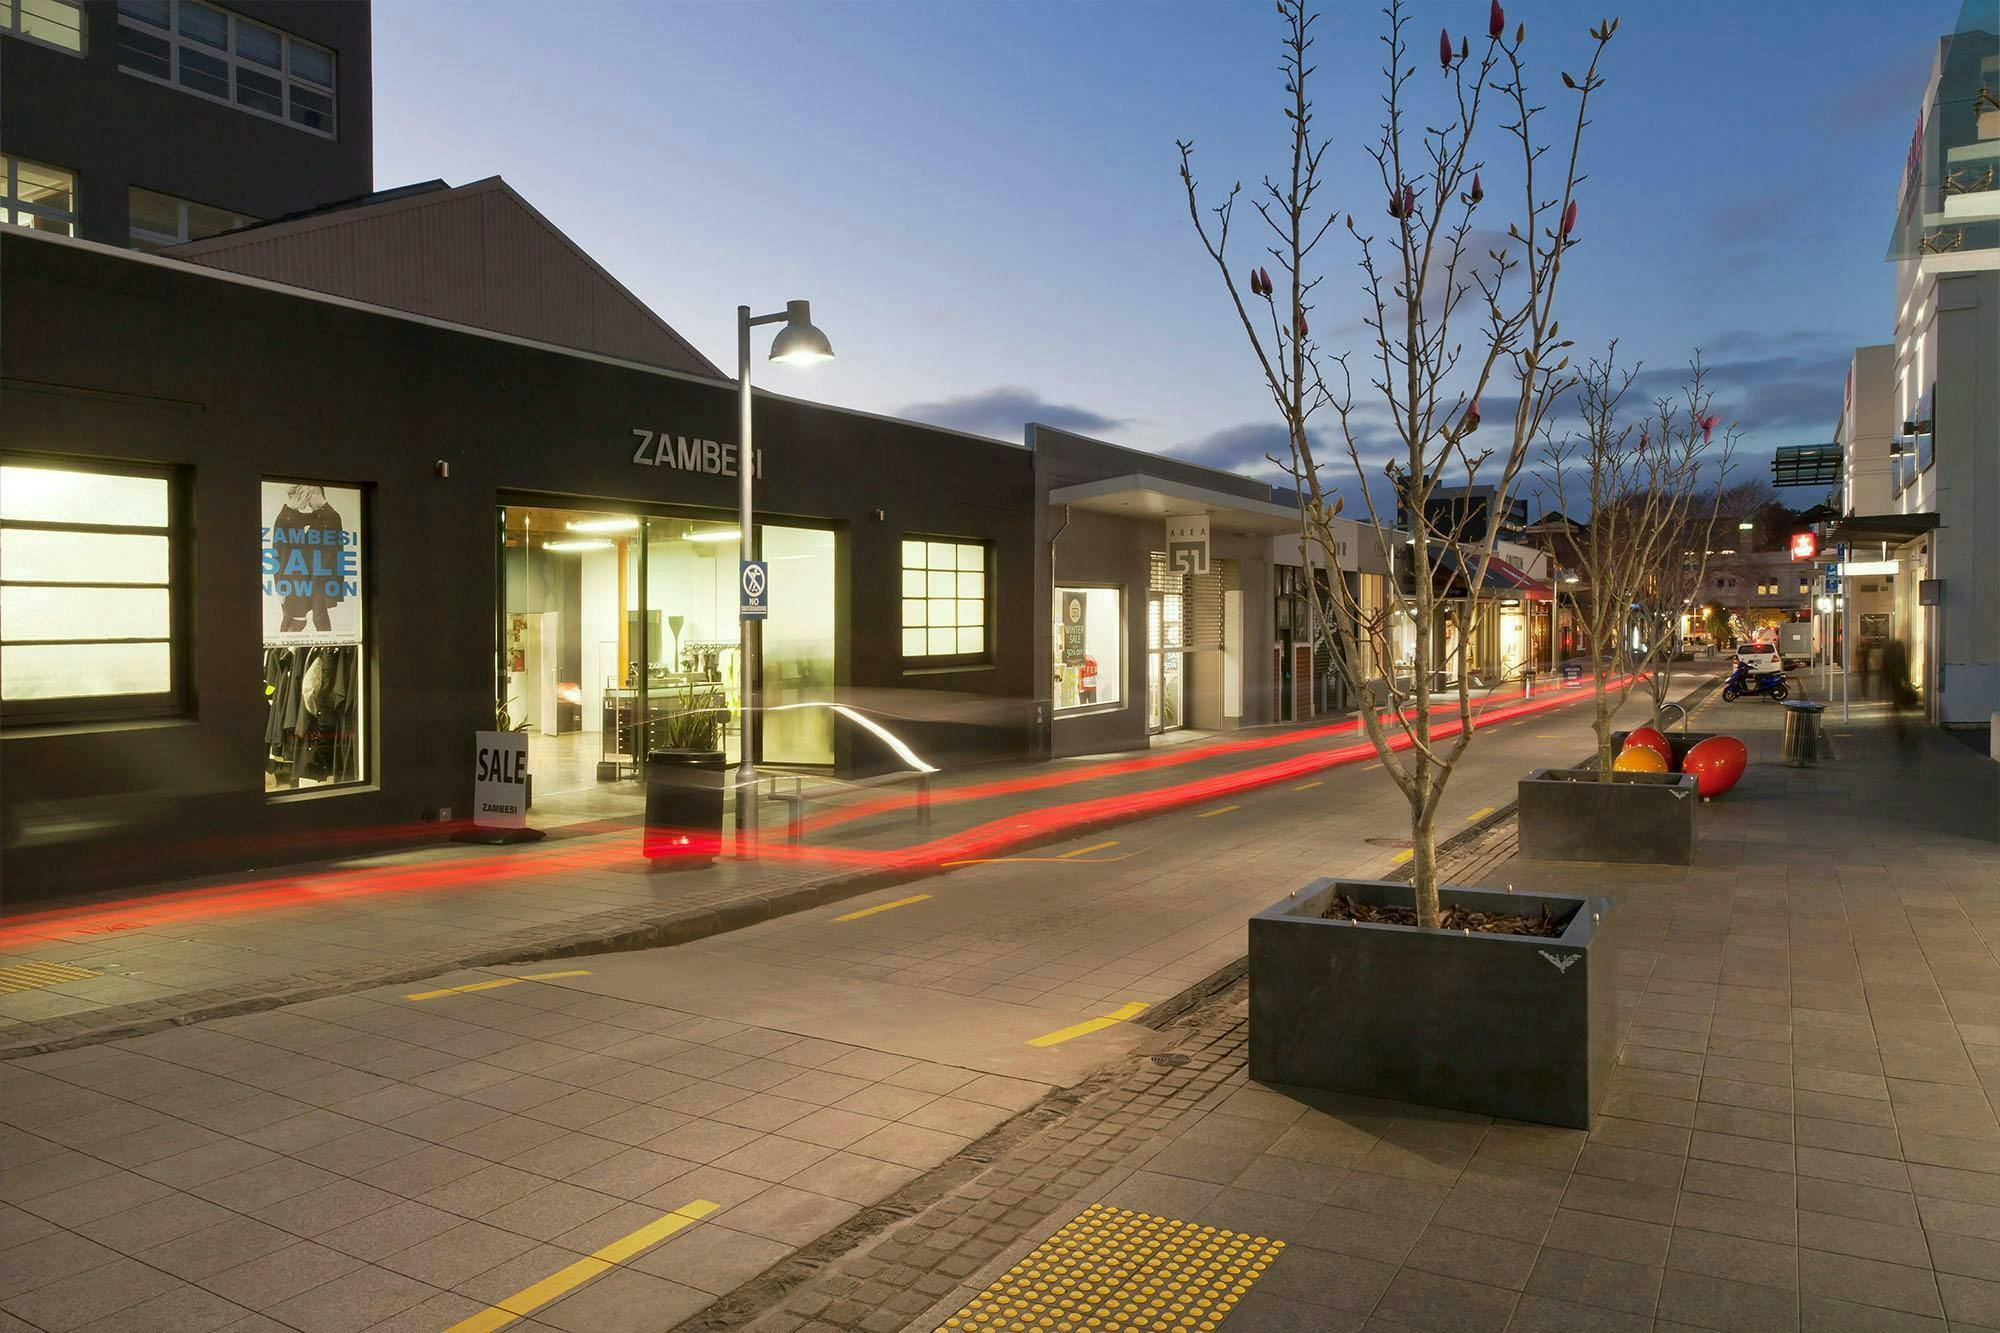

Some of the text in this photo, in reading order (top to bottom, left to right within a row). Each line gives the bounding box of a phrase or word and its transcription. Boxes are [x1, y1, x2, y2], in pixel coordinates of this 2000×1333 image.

[261, 527, 358, 546] ZAMBESI
[1170, 528, 1206, 537] AREA
[262, 548, 358, 576] SALE
[1174, 549, 1203, 575] 51
[262, 580, 358, 597] NOW ON
[748, 597, 760, 606] NO
[1069, 634, 1081, 644] SALE
[477, 748, 526, 784] SALE
[482, 803, 518, 815] ZAMBESI
